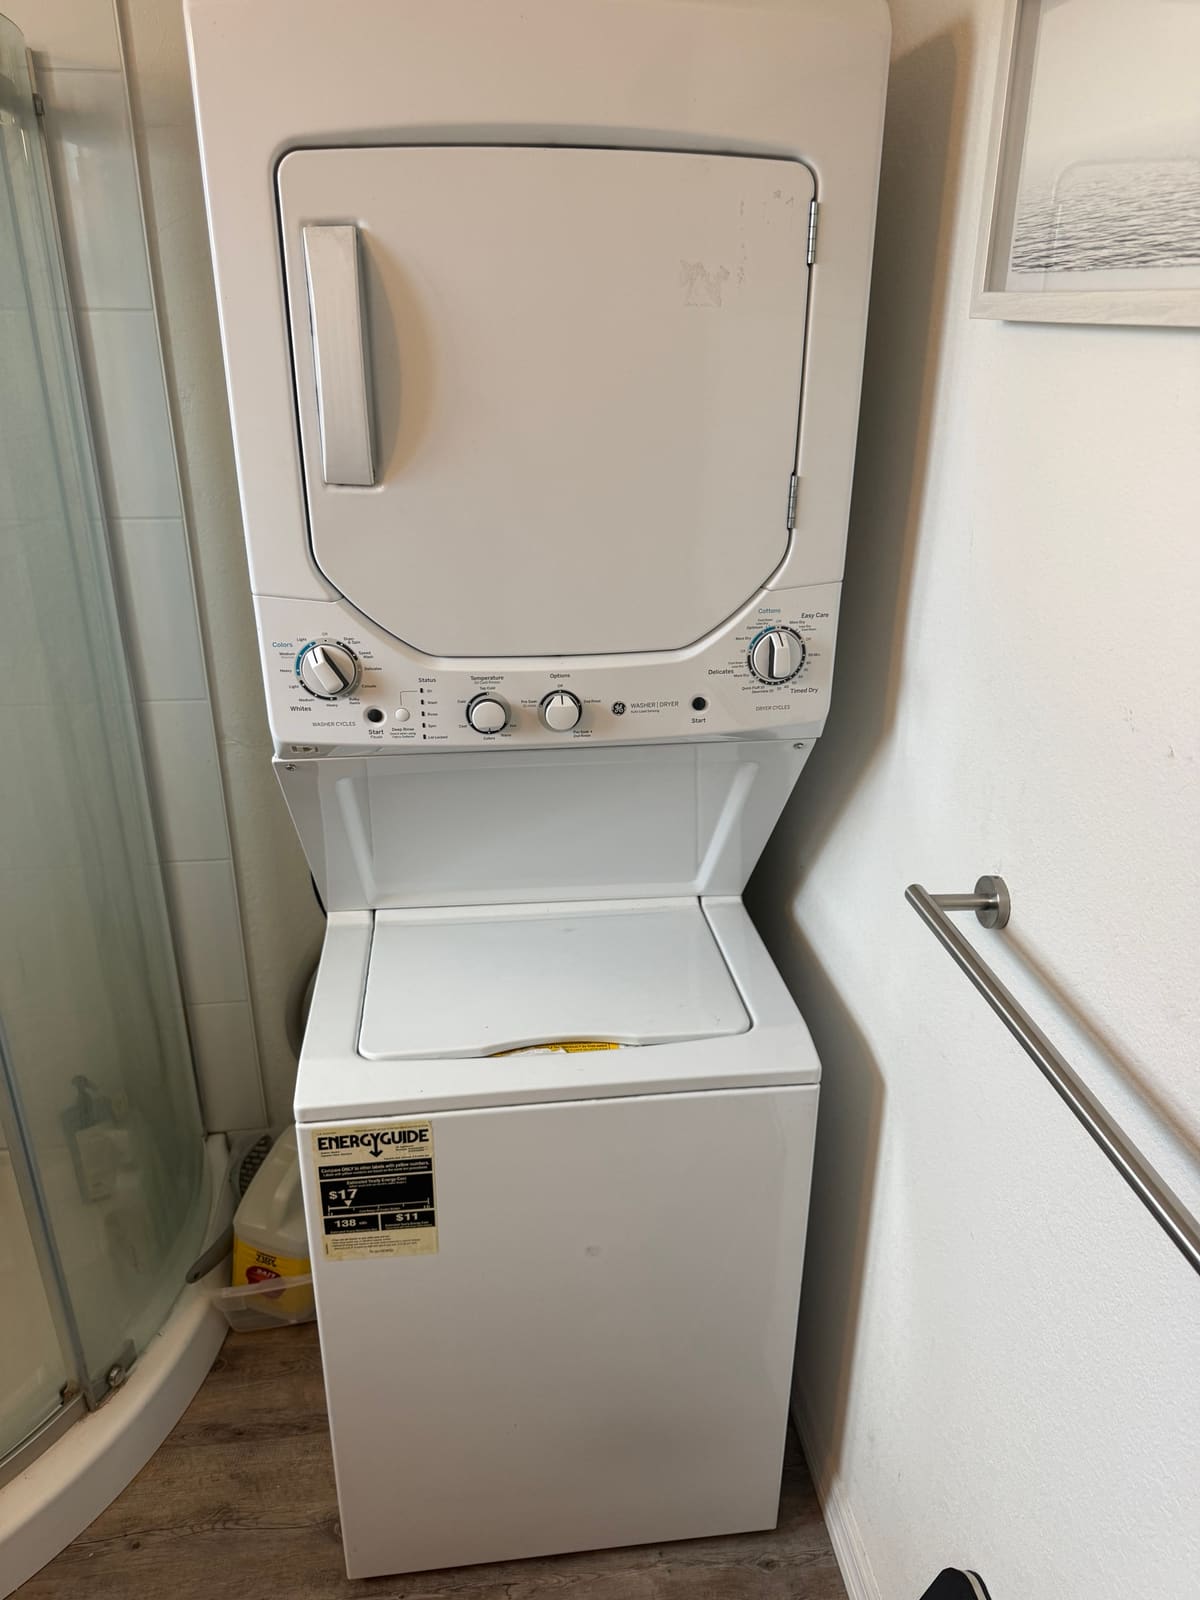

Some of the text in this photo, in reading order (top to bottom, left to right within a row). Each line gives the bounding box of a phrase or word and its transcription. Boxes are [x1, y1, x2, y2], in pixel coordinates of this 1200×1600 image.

[317, 1128, 430, 1152] ENERGYGUIDE
[328, 1188, 358, 1200] $17
[395, 1212, 418, 1222] $11
[334, 1219, 356, 1228] 138
